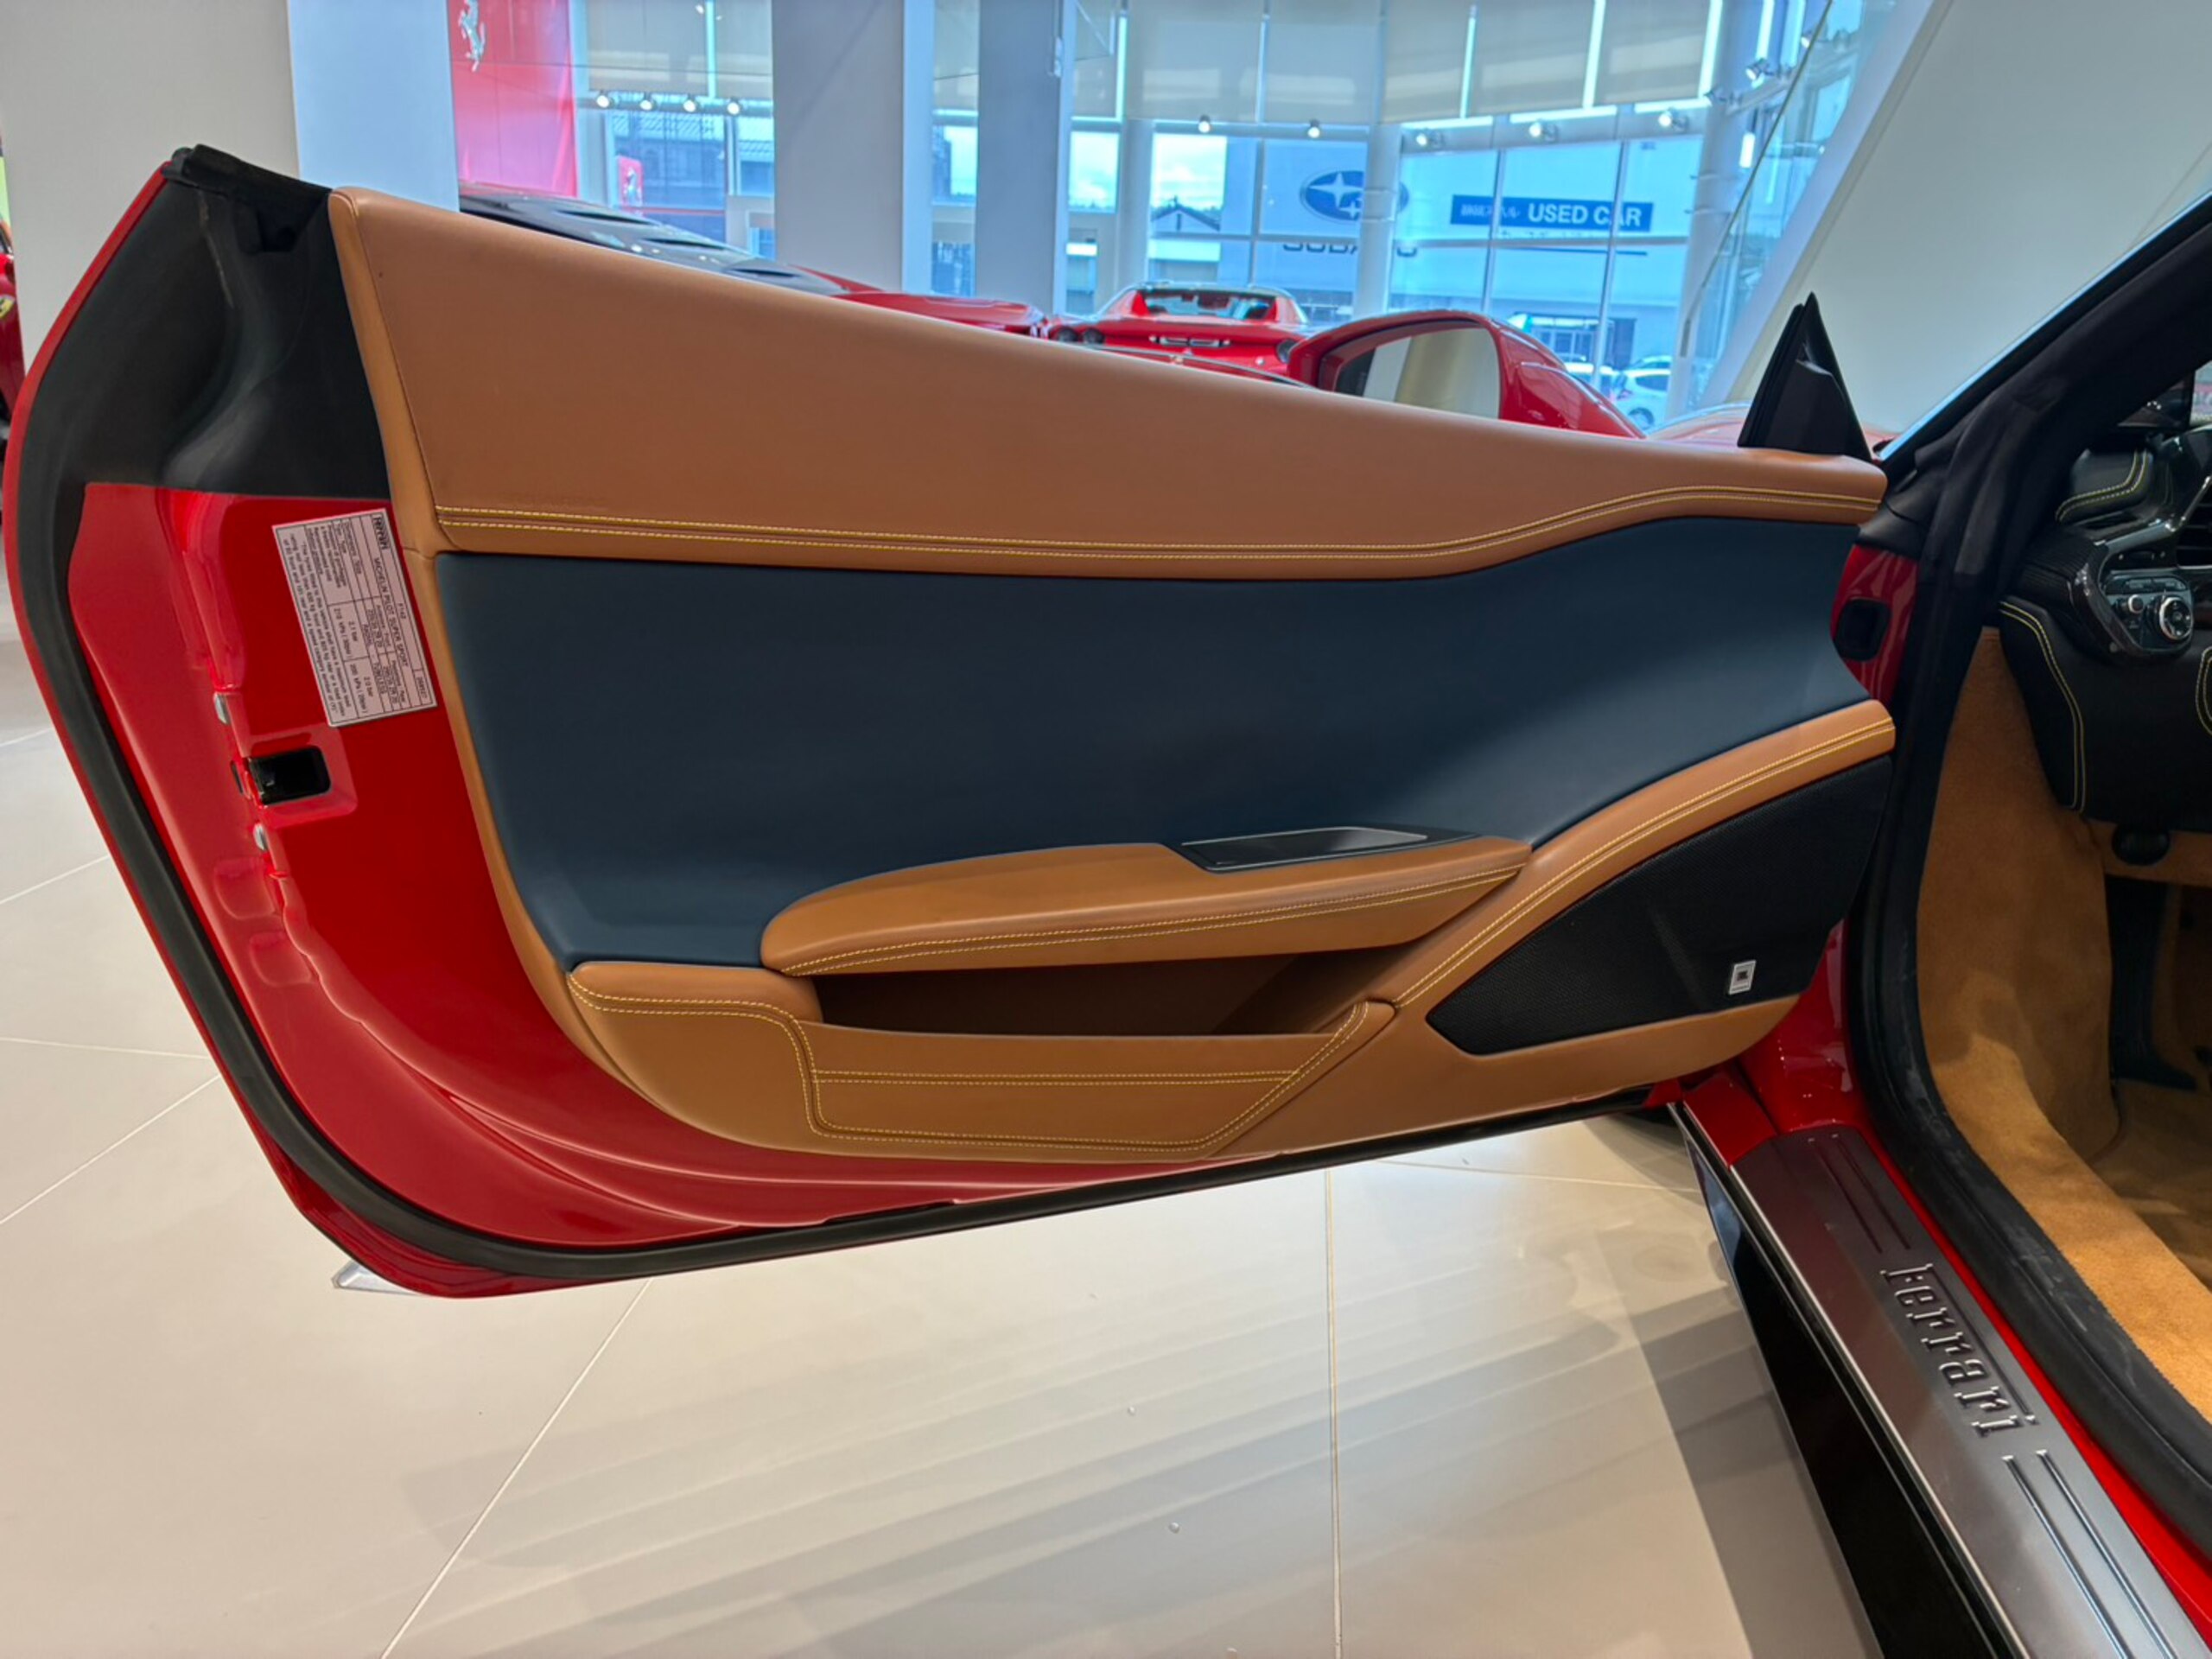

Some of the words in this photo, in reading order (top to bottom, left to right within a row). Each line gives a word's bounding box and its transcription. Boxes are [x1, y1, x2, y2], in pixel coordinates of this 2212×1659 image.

[1528, 202, 1587, 225] USED
[372, 557, 388, 593] MICHELIN
[382, 594, 394, 615] PILOT
[388, 617, 402, 642] SUPER
[395, 643, 409, 667] SPORT
[1879, 1262, 2035, 1437] Ferrari
